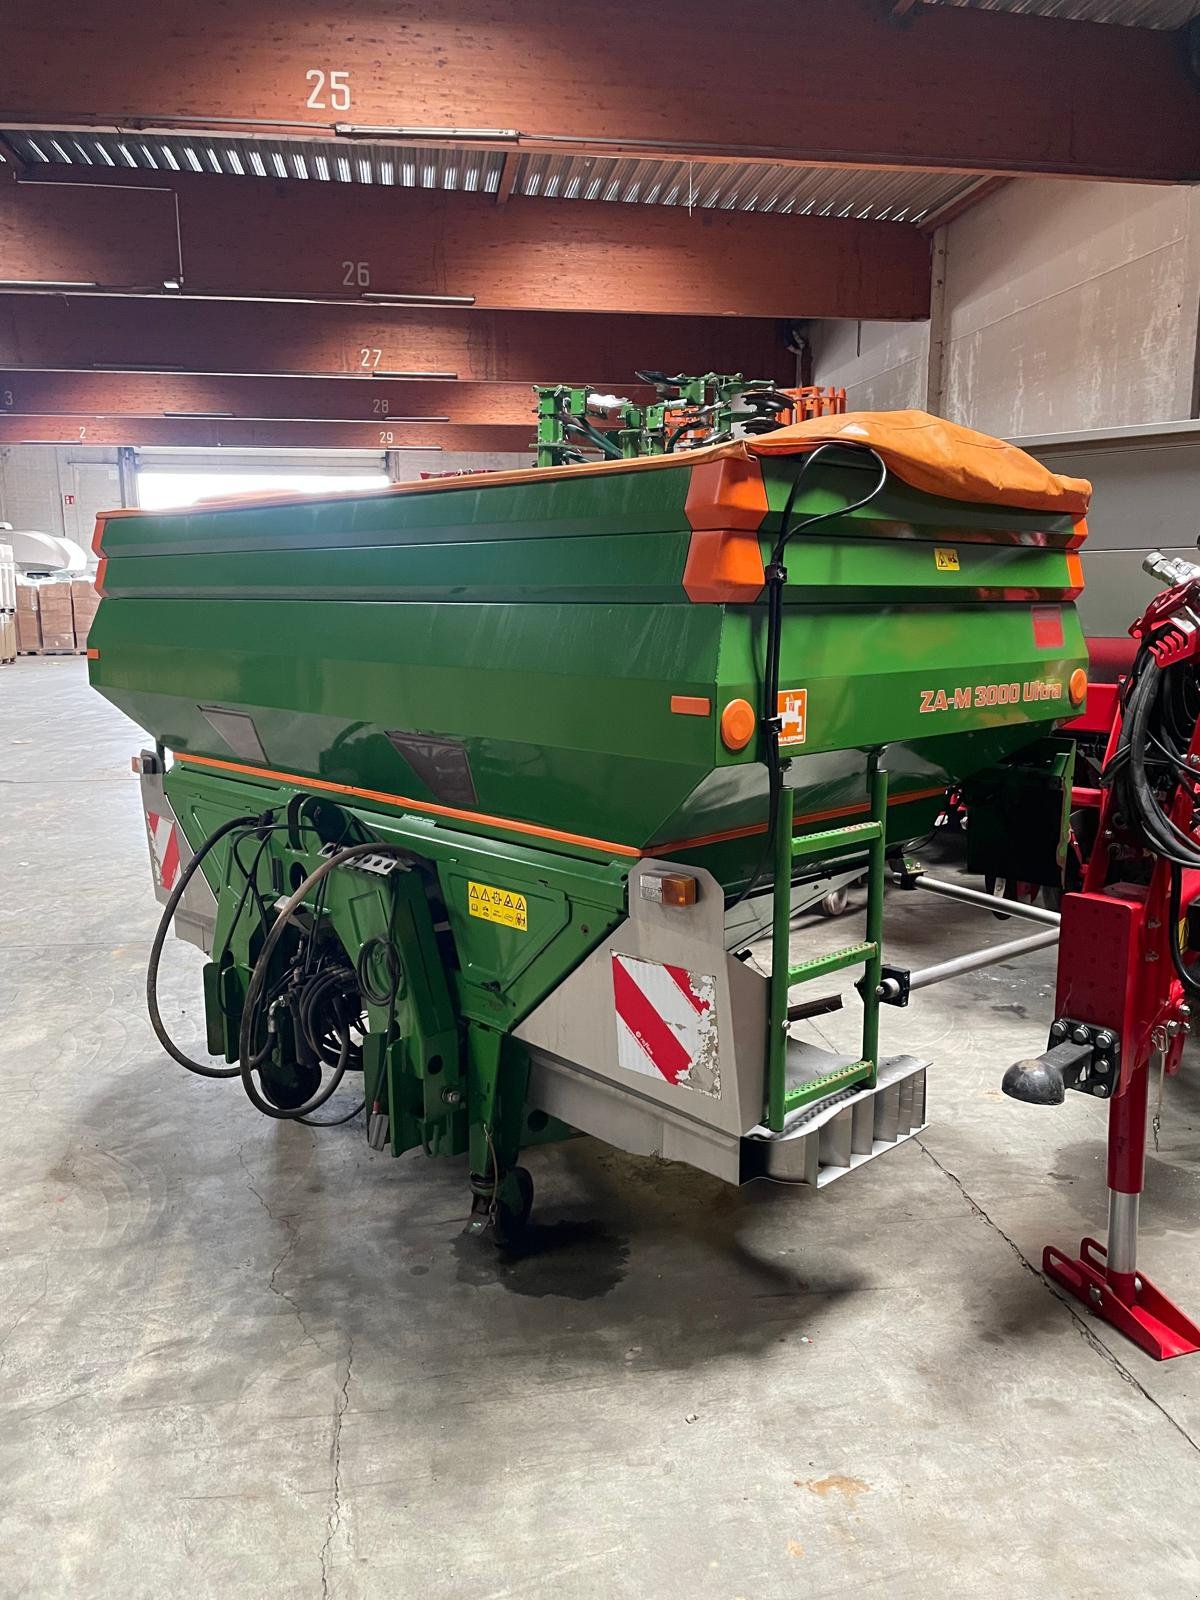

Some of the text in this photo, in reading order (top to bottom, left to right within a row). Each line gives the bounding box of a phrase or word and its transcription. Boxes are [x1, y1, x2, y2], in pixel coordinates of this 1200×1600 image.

[306, 69, 350, 110] 25
[342, 261, 370, 287] 26
[360, 348, 382, 367] 27
[4, 390, 14, 406] 3
[372, 399, 389, 414] 28
[79, 426, 87, 439] 2
[379, 431, 394, 444] 29
[920, 680, 1062, 713] ZA-M 3000 Ultra
